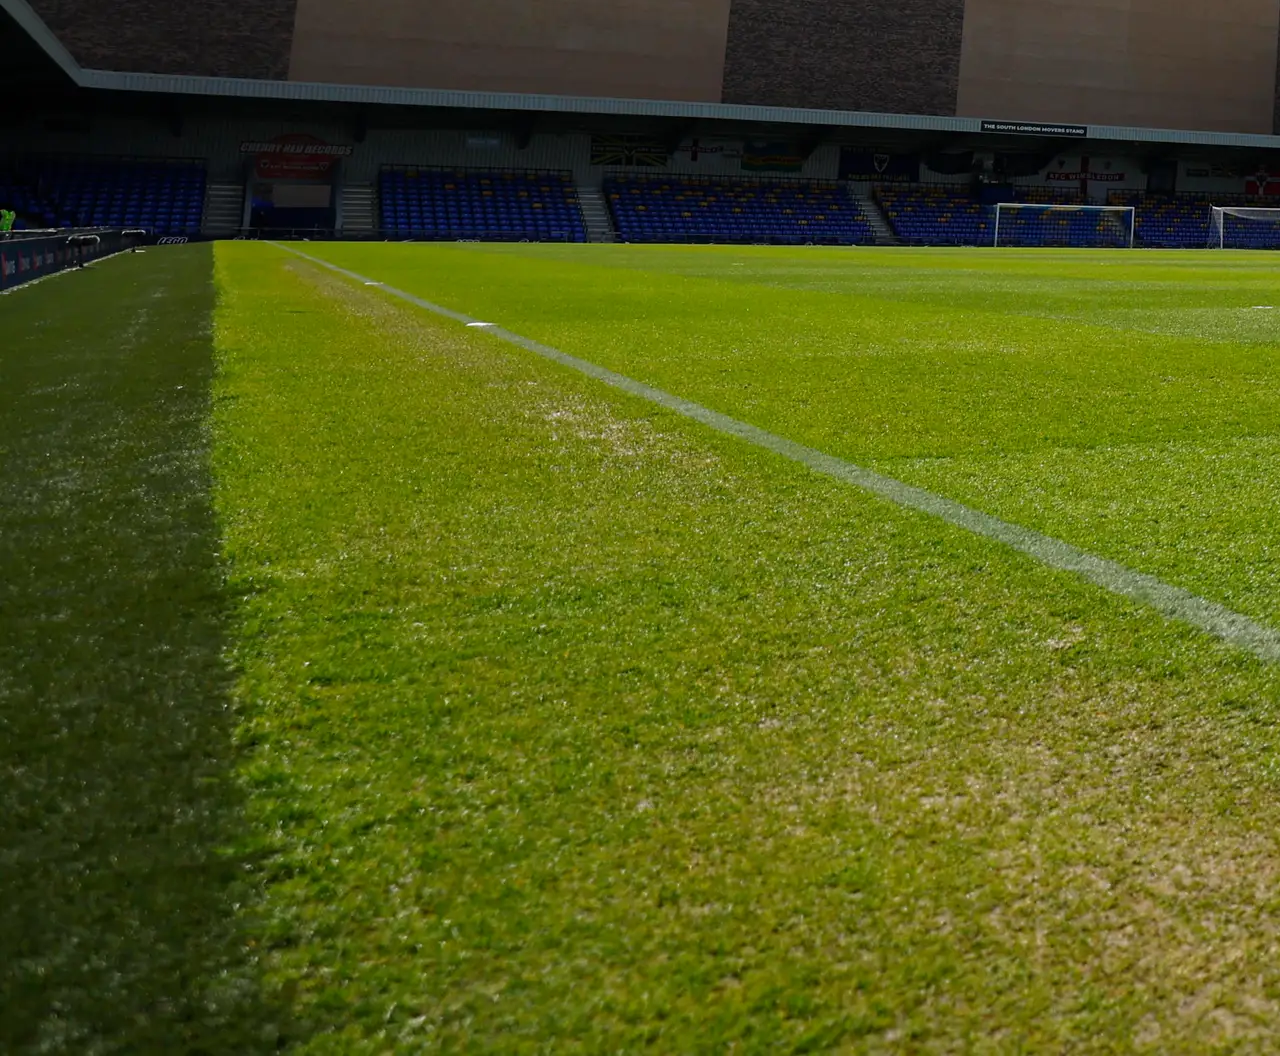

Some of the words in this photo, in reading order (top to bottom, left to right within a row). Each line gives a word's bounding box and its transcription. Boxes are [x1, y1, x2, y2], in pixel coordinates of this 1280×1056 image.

[240, 142, 283, 153] CHERRY
[283, 143, 304, 154] RED
[304, 144, 353, 155] RECORDS
[1069, 173, 1120, 181] WIMBLEDON
